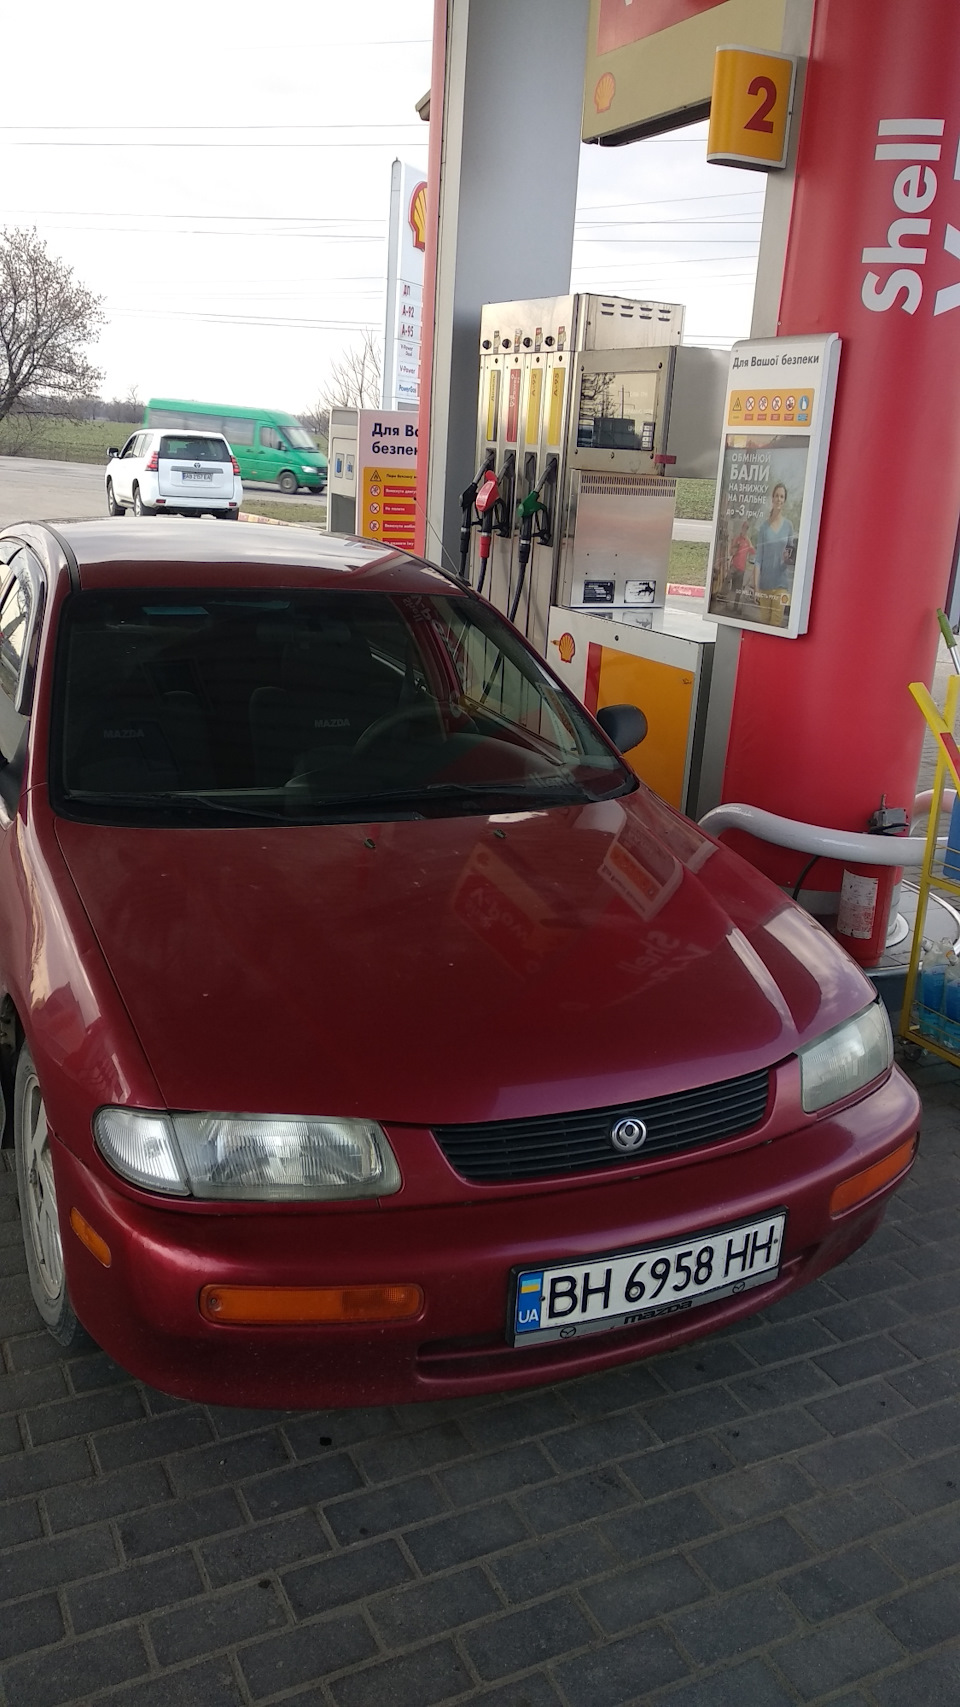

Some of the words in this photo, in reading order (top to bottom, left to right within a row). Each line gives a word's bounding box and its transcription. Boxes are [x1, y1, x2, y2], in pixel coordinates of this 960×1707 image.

[743, 76, 778, 134] 2
[861, 119, 945, 315] Shell
[401, 304, 416, 319] А-92
[401, 324, 415, 338] А-95
[733, 357, 749, 369] Для
[751, 355, 779, 367] Вашої
[781, 354, 820, 365] безпеки
[371, 422, 400, 438] Для
[731, 452, 771, 463] ОБМІНЮЙ
[730, 463, 771, 482] БАЛИ
[728, 483, 739, 492] НА
[739, 483, 769, 493] ЗНИЖКУ
[728, 493, 738, 502] НА
[738, 494, 767, 504] ПАЛЬНЕ
[314, 718, 350, 728] MAZDA
[103, 729, 145, 739] MAZDA
[548, 1268, 612, 1319] BH
[624, 1246, 714, 1303] 6958
[723, 1225, 775, 1277] HH
[518, 1309, 539, 1324] UA
[623, 1300, 693, 1325] mazda
